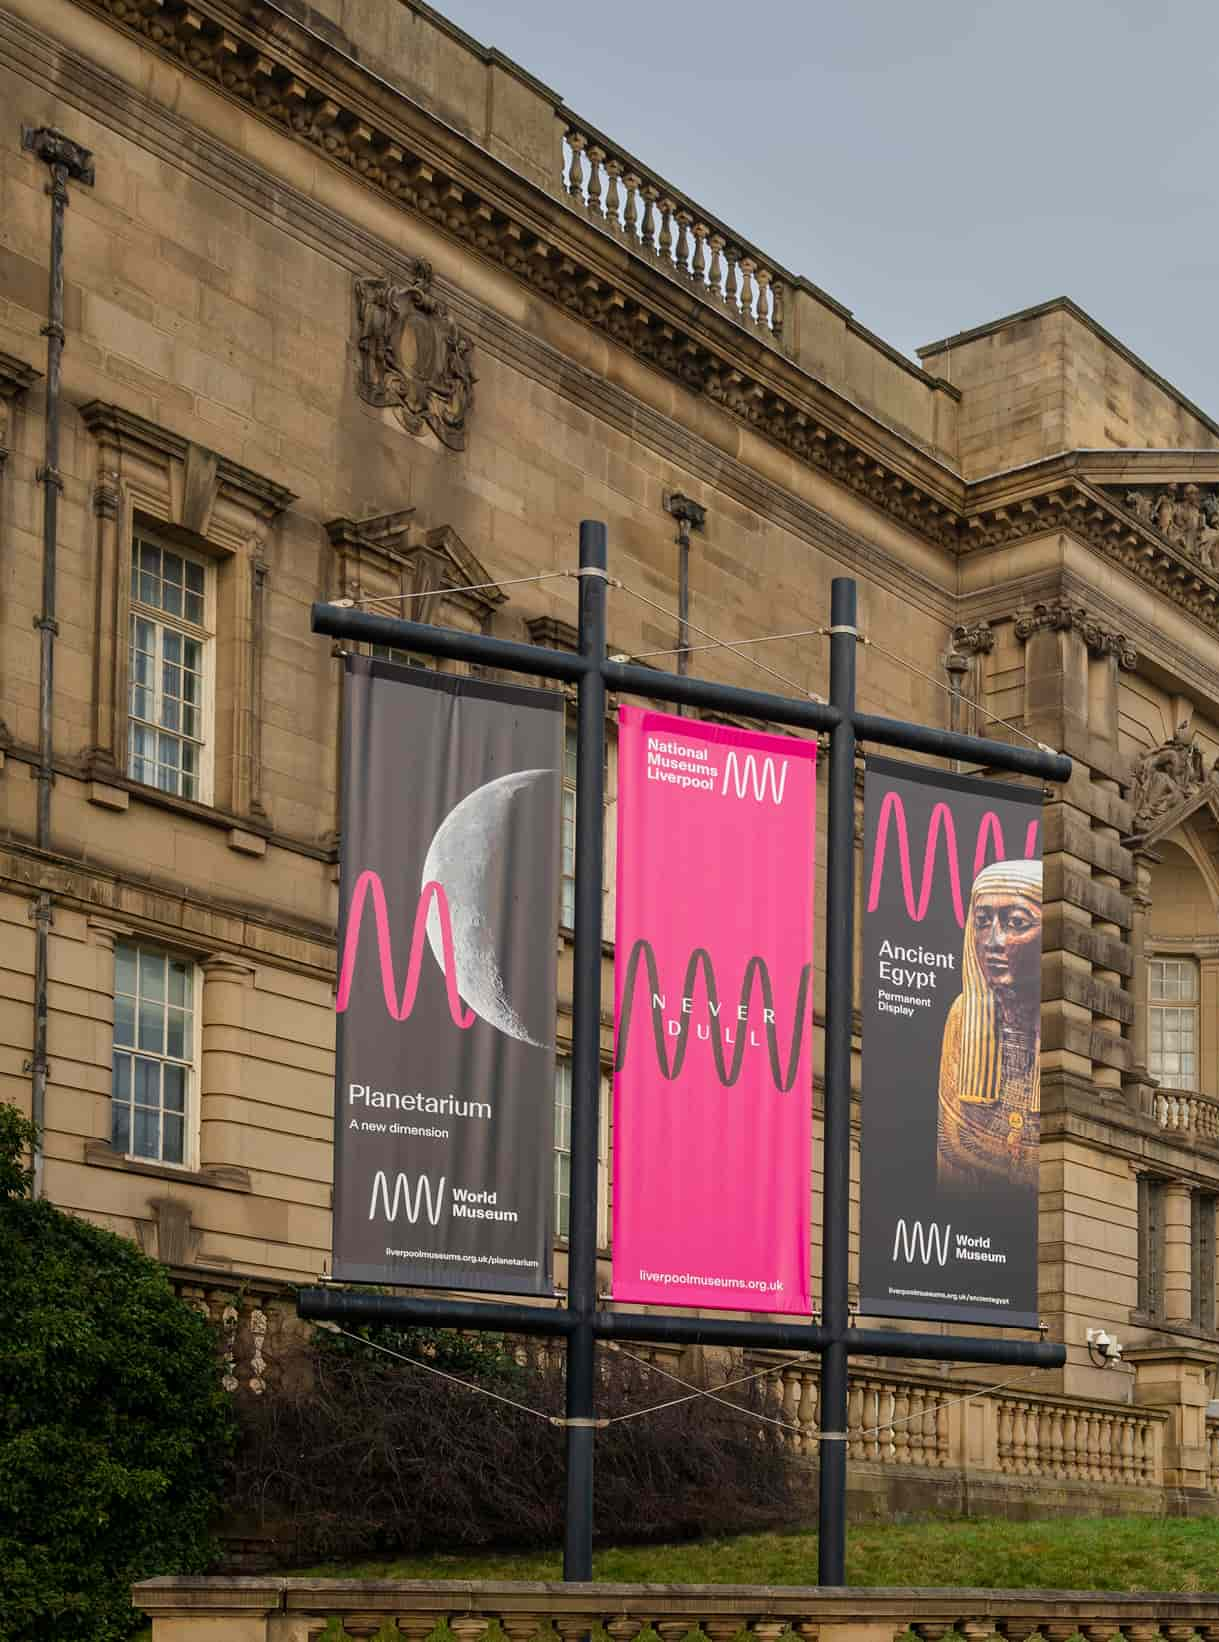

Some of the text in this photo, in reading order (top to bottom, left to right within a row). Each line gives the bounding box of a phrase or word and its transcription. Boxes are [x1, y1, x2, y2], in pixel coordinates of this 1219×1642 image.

[648, 737, 708, 761] National
[647, 752, 719, 777] Museums
[647, 767, 714, 791] Liverpool
[879, 940, 955, 969] Ancient
[879, 961, 937, 989] Egypt
[652, 993, 776, 1025] NEVER
[878, 989, 932, 1007] Permanent
[878, 1001, 915, 1017] Display
[668, 1020, 761, 1047] DULL
[349, 1083, 493, 1119] Planetarium
[349, 1119, 450, 1139] A new dimension
[452, 1188, 498, 1205] World
[452, 1204, 519, 1223] Museum
[956, 1233, 991, 1249] World
[385, 1248, 540, 1268] liverpoolmuseums.org.uk/planetarium
[955, 1247, 1008, 1264] Museum
[639, 1269, 785, 1292] liverpoolmuseums.org.uk
